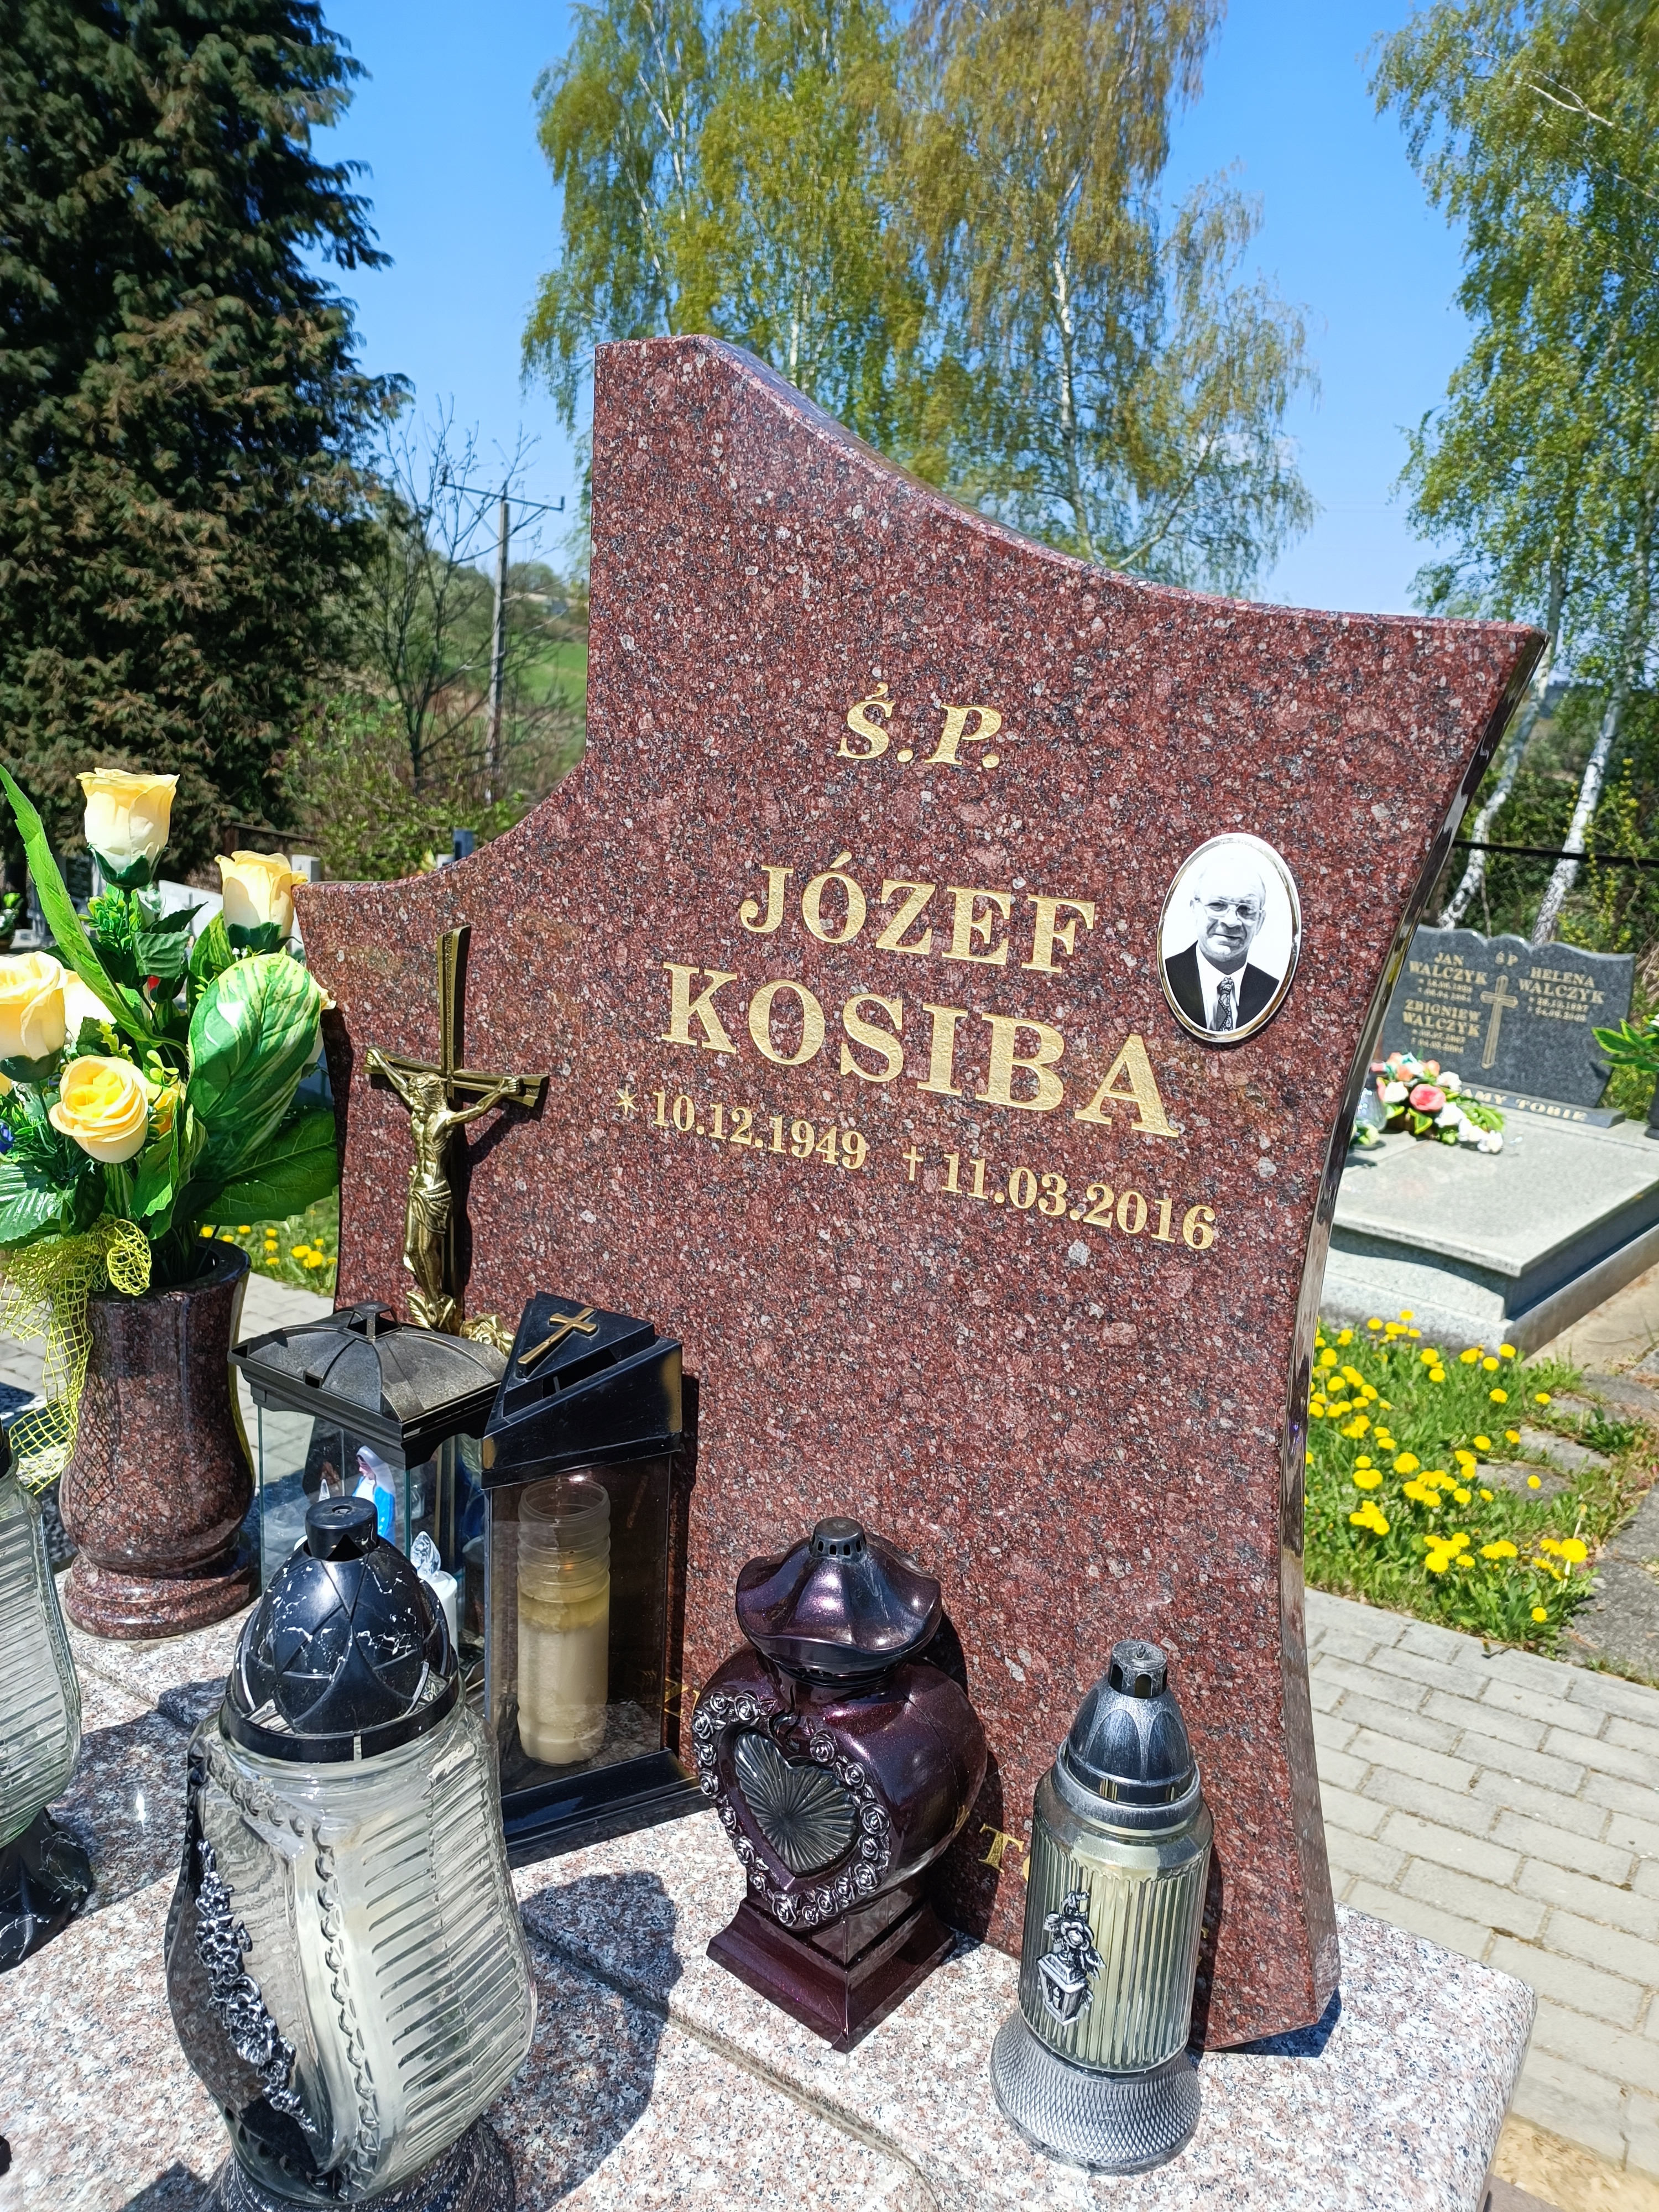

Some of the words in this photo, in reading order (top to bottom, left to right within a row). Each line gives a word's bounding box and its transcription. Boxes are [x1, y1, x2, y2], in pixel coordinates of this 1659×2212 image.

[739, 851, 1096, 974] JÓZEF
[1434, 952, 1465, 967] JAN
[1409, 961, 1488, 985] WALCZYK
[1530, 966, 1595, 988] HELENA
[1518, 978, 1605, 1005] WALCZYK
[1404, 999, 1481, 1022] ZBIGNIEW
[1402, 1011, 1480, 1037] WALCZYK
[661, 961, 1180, 1139] KOSIBA
[1461, 1088, 1508, 1105] AMY
[1515, 1098, 1588, 1122] TOBIE
[652, 1090, 867, 1170] 10.12.1949
[941, 1151, 1215, 1250] 11.03.2016
